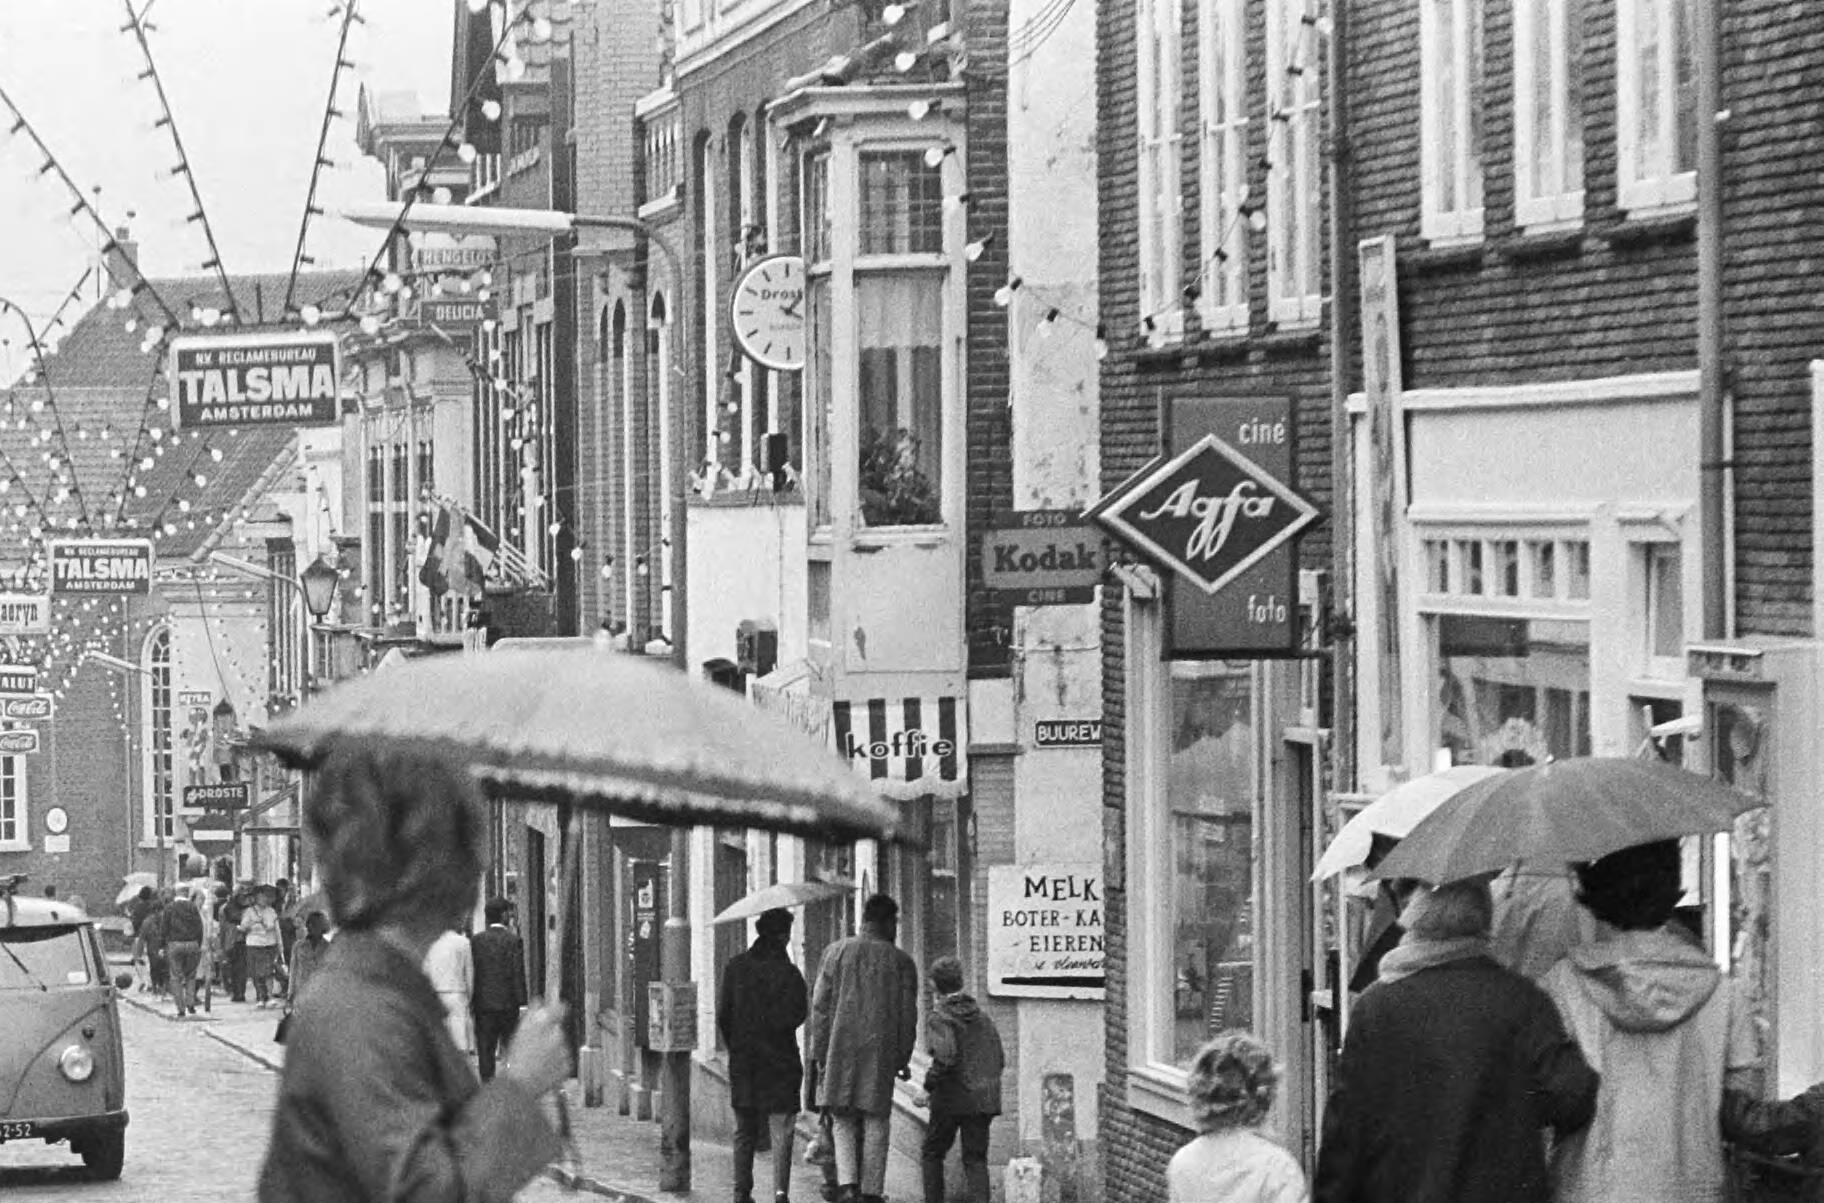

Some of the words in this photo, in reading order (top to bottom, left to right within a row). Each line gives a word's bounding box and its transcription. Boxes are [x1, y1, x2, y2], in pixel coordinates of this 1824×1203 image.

[218, 347, 317, 364] RECLAMEBUREAU
[178, 364, 335, 405] TALSMA
[200, 402, 313, 421] AMSTERDAM
[1238, 417, 1285, 444] ciné
[1022, 512, 1067, 526] FOTO
[1139, 478, 1275, 562] Agfa
[54, 557, 148, 579] TALSMA
[993, 543, 1097, 572] Kodak
[65, 580, 136, 590] AMSTERDAM
[1247, 594, 1286, 623] foto
[846, 728, 953, 759] koffie
[1037, 723, 1102, 742] BUUREW
[198, 786, 244, 799] DROSTE
[1024, 875, 1099, 901] MELK
[1029, 935, 1103, 952] EIEREN
